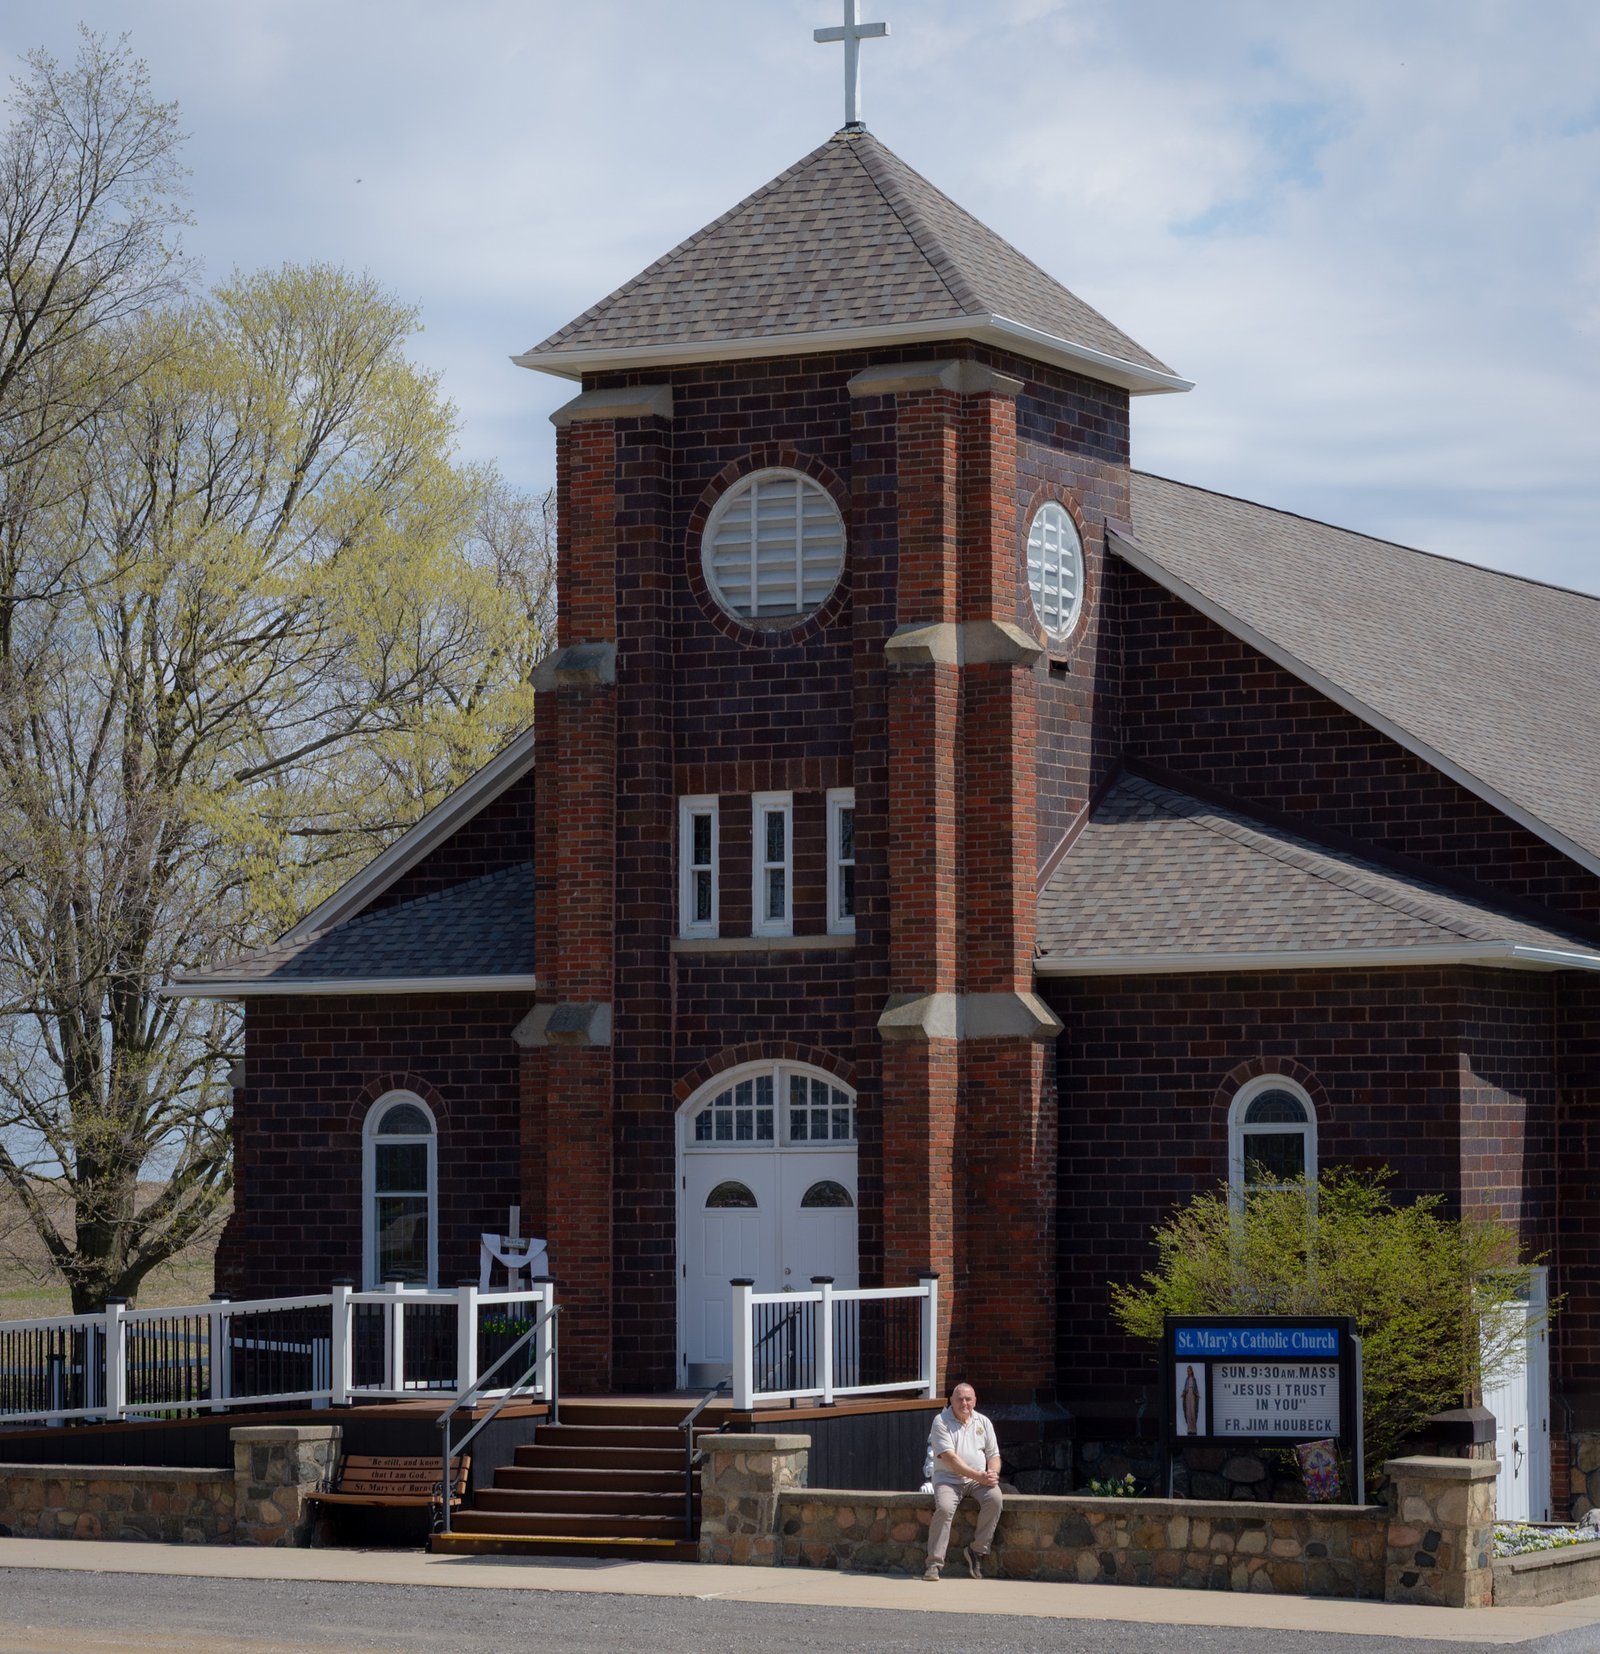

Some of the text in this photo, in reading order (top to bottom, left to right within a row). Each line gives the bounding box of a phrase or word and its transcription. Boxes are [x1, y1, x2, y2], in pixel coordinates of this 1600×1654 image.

[1178, 1331, 1336, 1352] St. Mary's Catholic Church
[1224, 1383, 1326, 1396] "JESUS I TRUST
[1256, 1398, 1306, 1411] IN YOU"
[1274, 1418, 1332, 1431] HOUBECK
[384, 1459, 401, 1467] still,
[403, 1459, 418, 1467] and
[420, 1459, 439, 1467] know
[371, 1470, 387, 1478] that
[368, 1484, 395, 1493] Mary's
